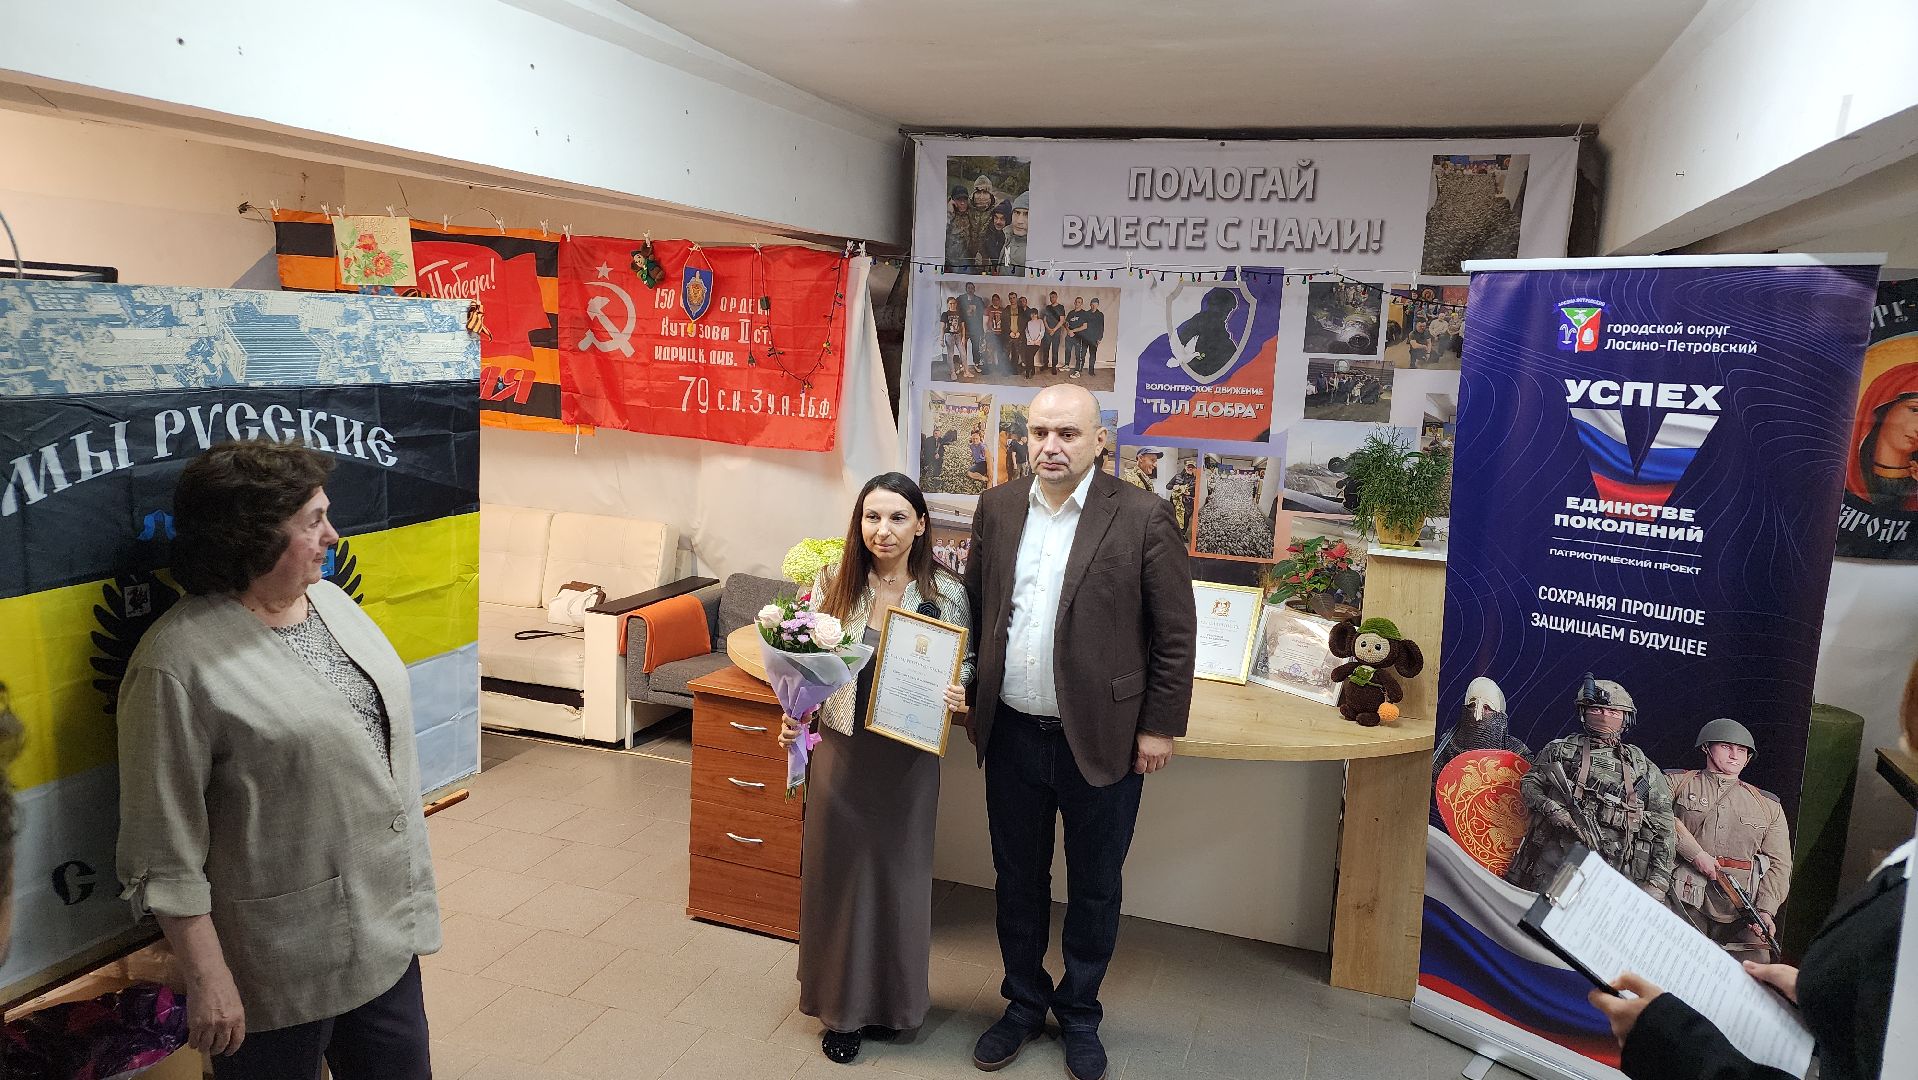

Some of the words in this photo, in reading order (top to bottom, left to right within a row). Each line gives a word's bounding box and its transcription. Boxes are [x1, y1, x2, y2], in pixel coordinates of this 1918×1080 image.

[1127, 159, 1317, 200] ПОМОГАЙ
[1061, 214, 1207, 249] ВМЕСТЕ
[1215, 216, 1241, 250] С
[1250, 217, 1384, 252] НАМИ!
[654, 287, 676, 310] 150
[1606, 321, 1684, 337] городской
[1687, 325, 1731, 338] округ
[1604, 338, 1758, 355] Лосино-Петровский
[678, 375, 709, 414] 79
[1145, 382, 1213, 394] ВОЛОНТЕРСКОЕ
[1214, 385, 1264, 396] ДВИЖЕНИЕ
[1564, 378, 1725, 411] УСПЕХ
[1, 420, 135, 517] МЫ
[1566, 496, 1696, 522] ЕДИНСТВЕ
[1553, 513, 1704, 543] ПОКОЛЕНИЙ
[1549, 548, 1653, 569] ПАТРИОТИЧЕСКИЙ
[1654, 561, 1702, 576] ПРОЕКТ
[1538, 585, 1617, 614] СОХРАНЯЯ
[1620, 597, 1706, 627] ПРОШЛОЕ
[1530, 612, 1626, 642] ЗАЩИЩАЕМ
[1628, 629, 1708, 657] БУДУЩЕЕ
